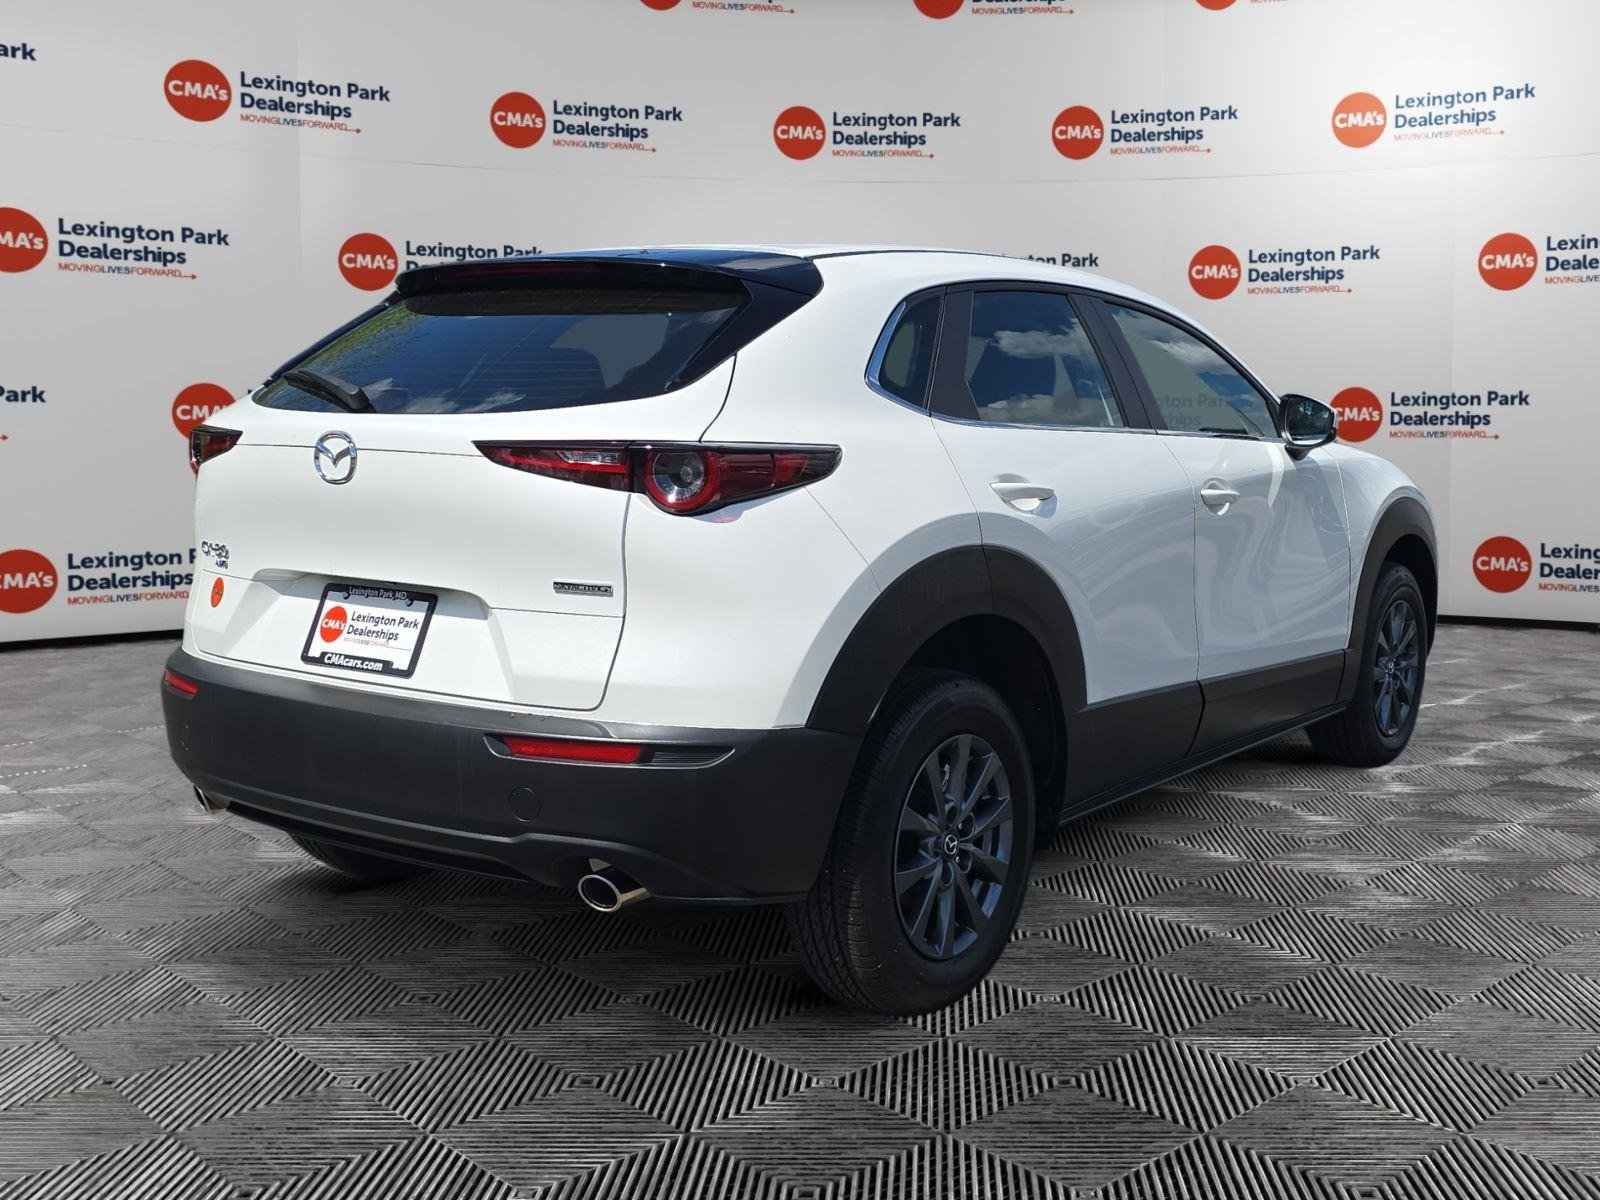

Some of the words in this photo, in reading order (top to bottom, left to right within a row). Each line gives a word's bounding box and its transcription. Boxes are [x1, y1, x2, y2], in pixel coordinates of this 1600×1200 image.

[167, 79, 229, 101] CMA's
[240, 71, 341, 97] Lexington
[347, 82, 391, 102] Park
[1395, 91, 1486, 109] Lexington
[1492, 83, 1536, 100] Park
[240, 93, 352, 120] Dealerships
[553, 100, 639, 121] Lexington
[644, 105, 683, 121] Park
[1111, 109, 1195, 126] Lexington
[1200, 105, 1238, 121] Park
[240, 114, 348, 131] MOVINGLIVESFORWARD
[493, 111, 544, 129] CMA's
[833, 111, 917, 130] Lexington
[923, 112, 961, 127] Park
[1334, 110, 1385, 128] CMA's
[1394, 108, 1496, 129] Dealerships
[553, 120, 649, 141] Dealerships
[776, 125, 824, 140] CMA's
[833, 130, 927, 148] Dealerships
[1055, 125, 1102, 140] CMA's
[1110, 126, 1204, 143] Dealerships
[58, 218, 174, 243] Lexington
[181, 227, 230, 246] Park
[58, 240, 187, 267] Dealerships
[406, 240, 498, 261] Lexington
[1061, 253, 1099, 267] Park
[1248, 248, 1335, 266] Lexington
[1340, 245, 1380, 260] Park
[58, 262, 182, 277] MOVINGLIVESFORWARD
[342, 253, 396, 270] CMA's
[1481, 252, 1535, 270] CMA's
[1191, 264, 1239, 279] CMA's
[1247, 267, 1344, 284] Dealerships
[1390, 391, 1481, 410] Lexington
[1487, 390, 1530, 406] Park
[1390, 411, 1491, 429] Dealerships
[67, 551, 182, 571] Lexington
[1476, 556, 1529, 573] CMA's
[0, 571, 54, 590] MA's
[67, 570, 194, 591] Dealerships
[67, 591, 190, 606] MOVINGLIVESFORWARD
[349, 586, 379, 599] Lexington
[351, 611, 396, 627] Lexington
[397, 616, 420, 630] Park
[346, 624, 399, 643] Dealerships
[323, 653, 384, 672] CMAcars.com
